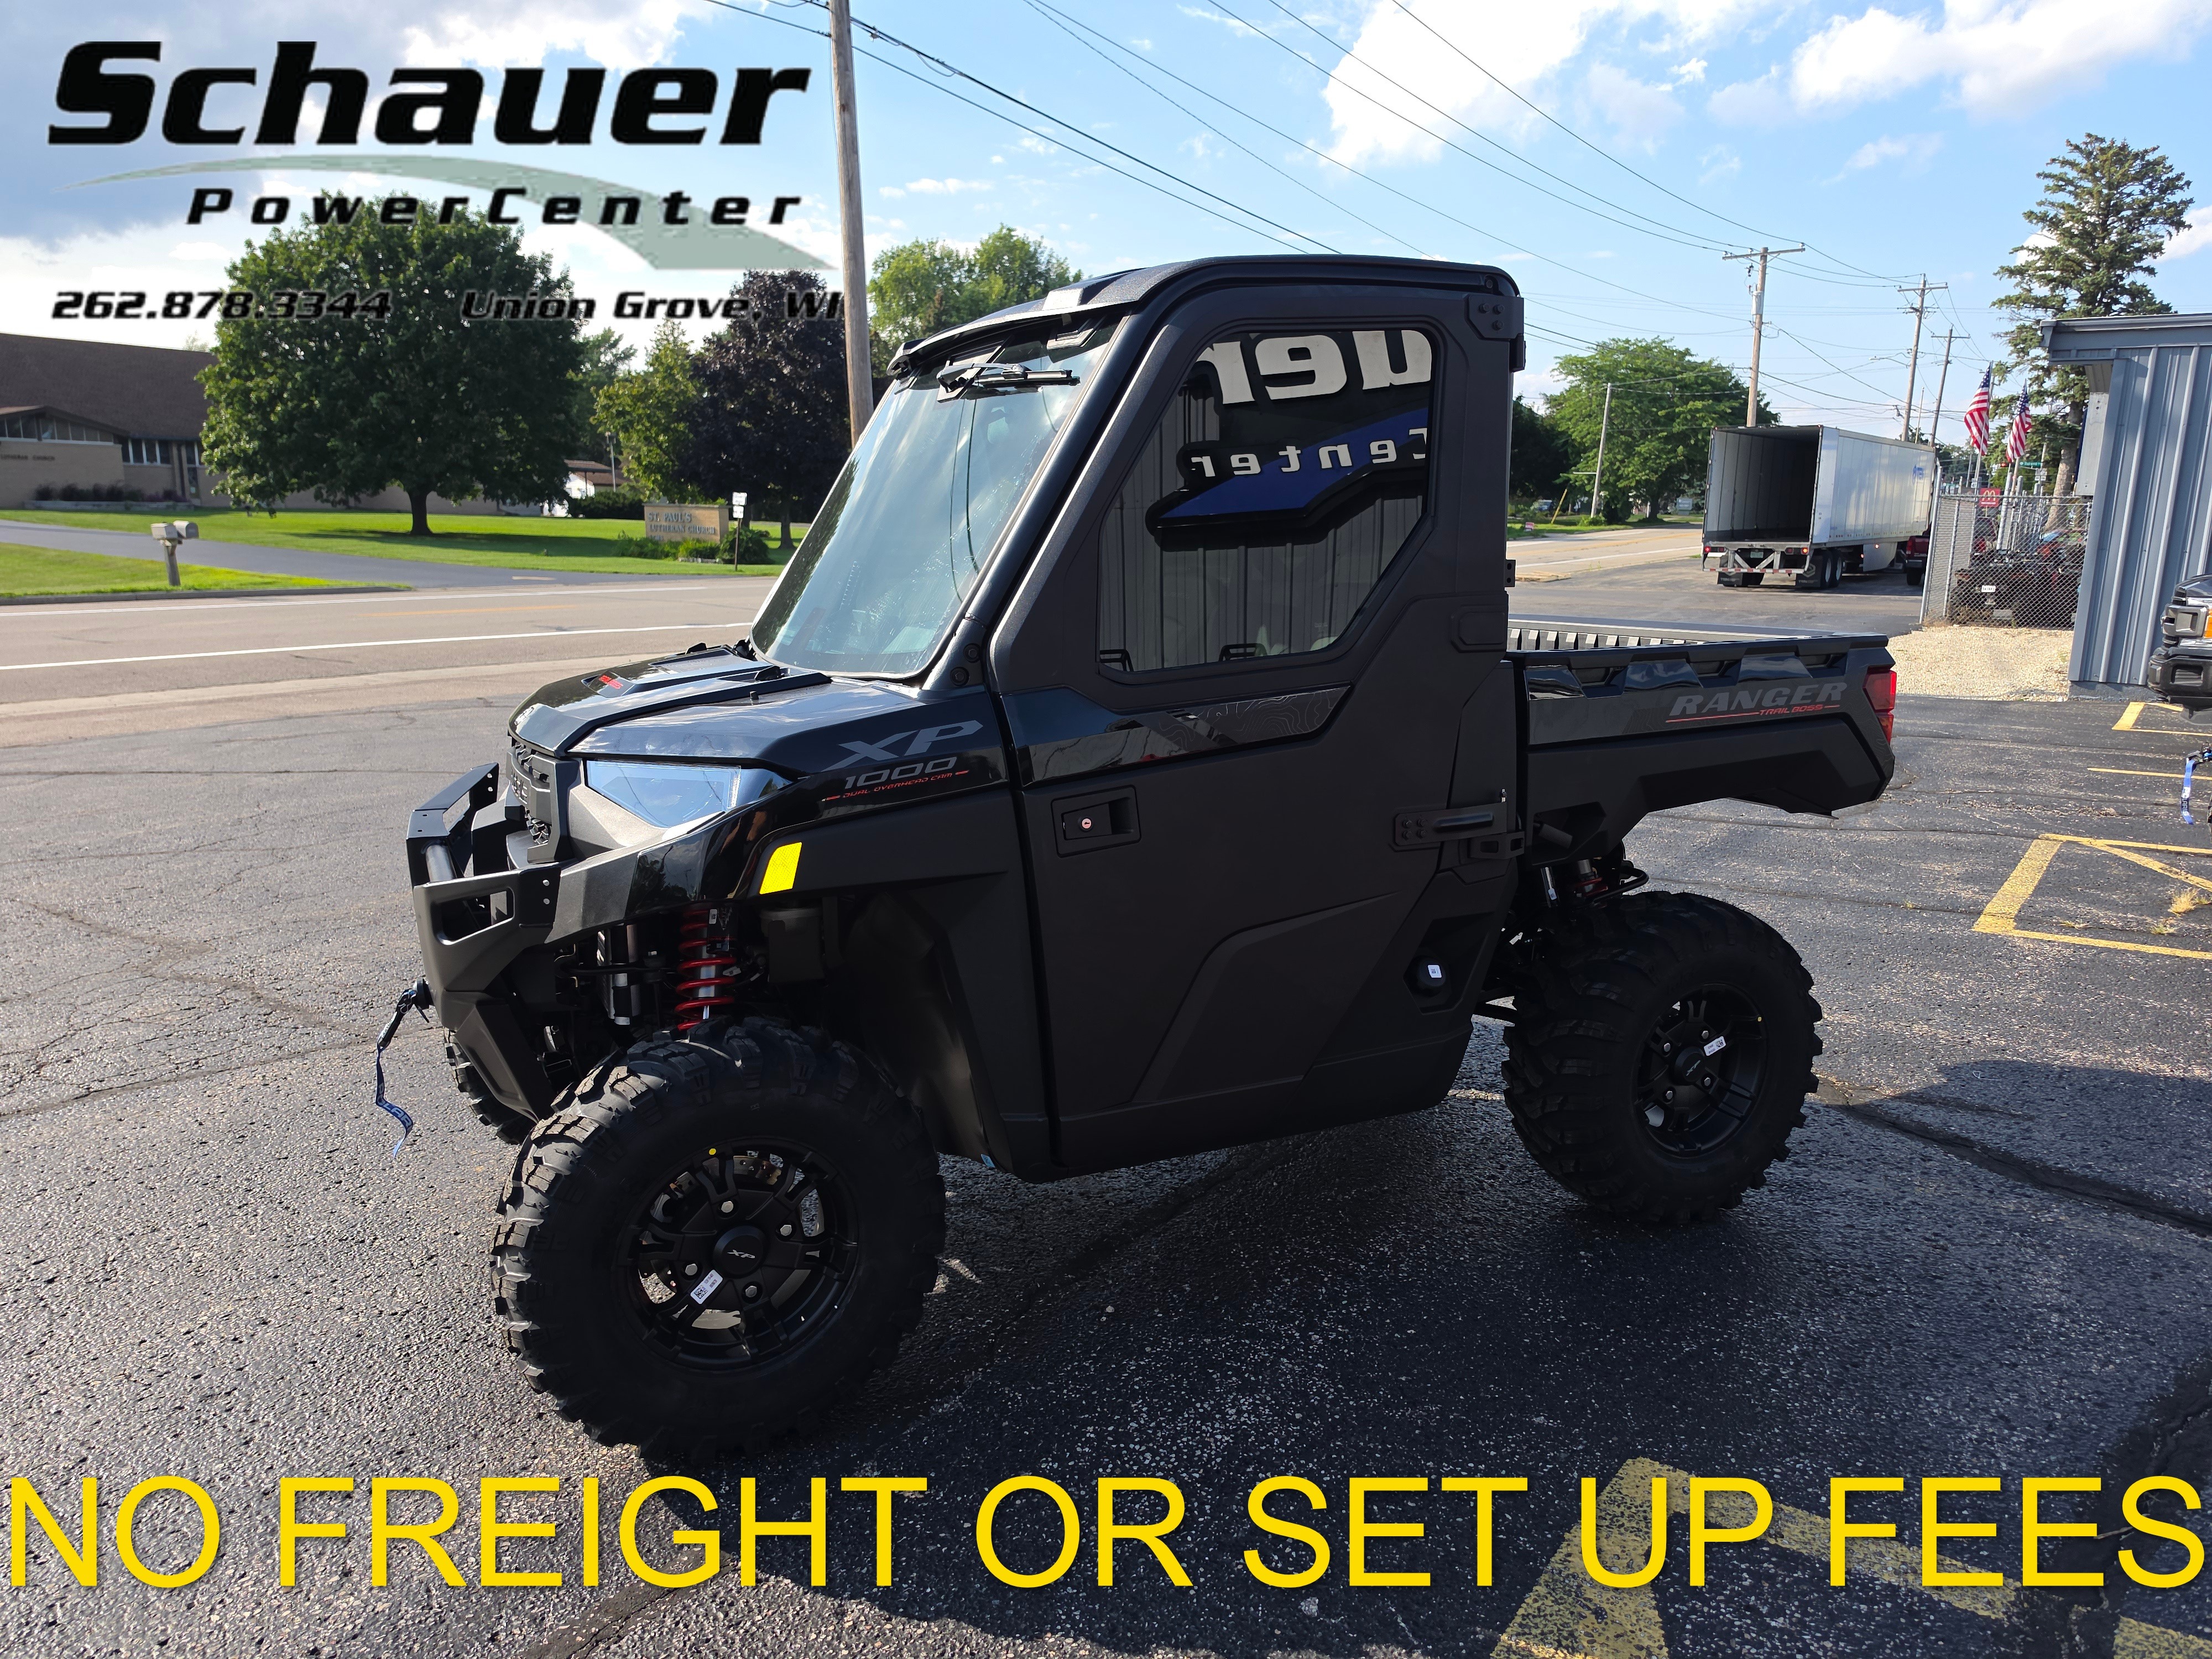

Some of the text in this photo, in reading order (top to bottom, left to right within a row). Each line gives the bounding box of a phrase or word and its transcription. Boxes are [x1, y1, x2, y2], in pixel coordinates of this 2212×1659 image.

[664, 512, 691, 523] PAUL'S
[650, 523, 716, 535] LUTHERAN CHURCH
[1669, 682, 1848, 717] RANGER
[1791, 705, 1823, 713] BOSS
[822, 720, 984, 772] XP
[844, 757, 957, 789] 1000
[843, 773, 952, 798] DUAL OVERHEAD CAM
[727, 1249, 755, 1259] XP
